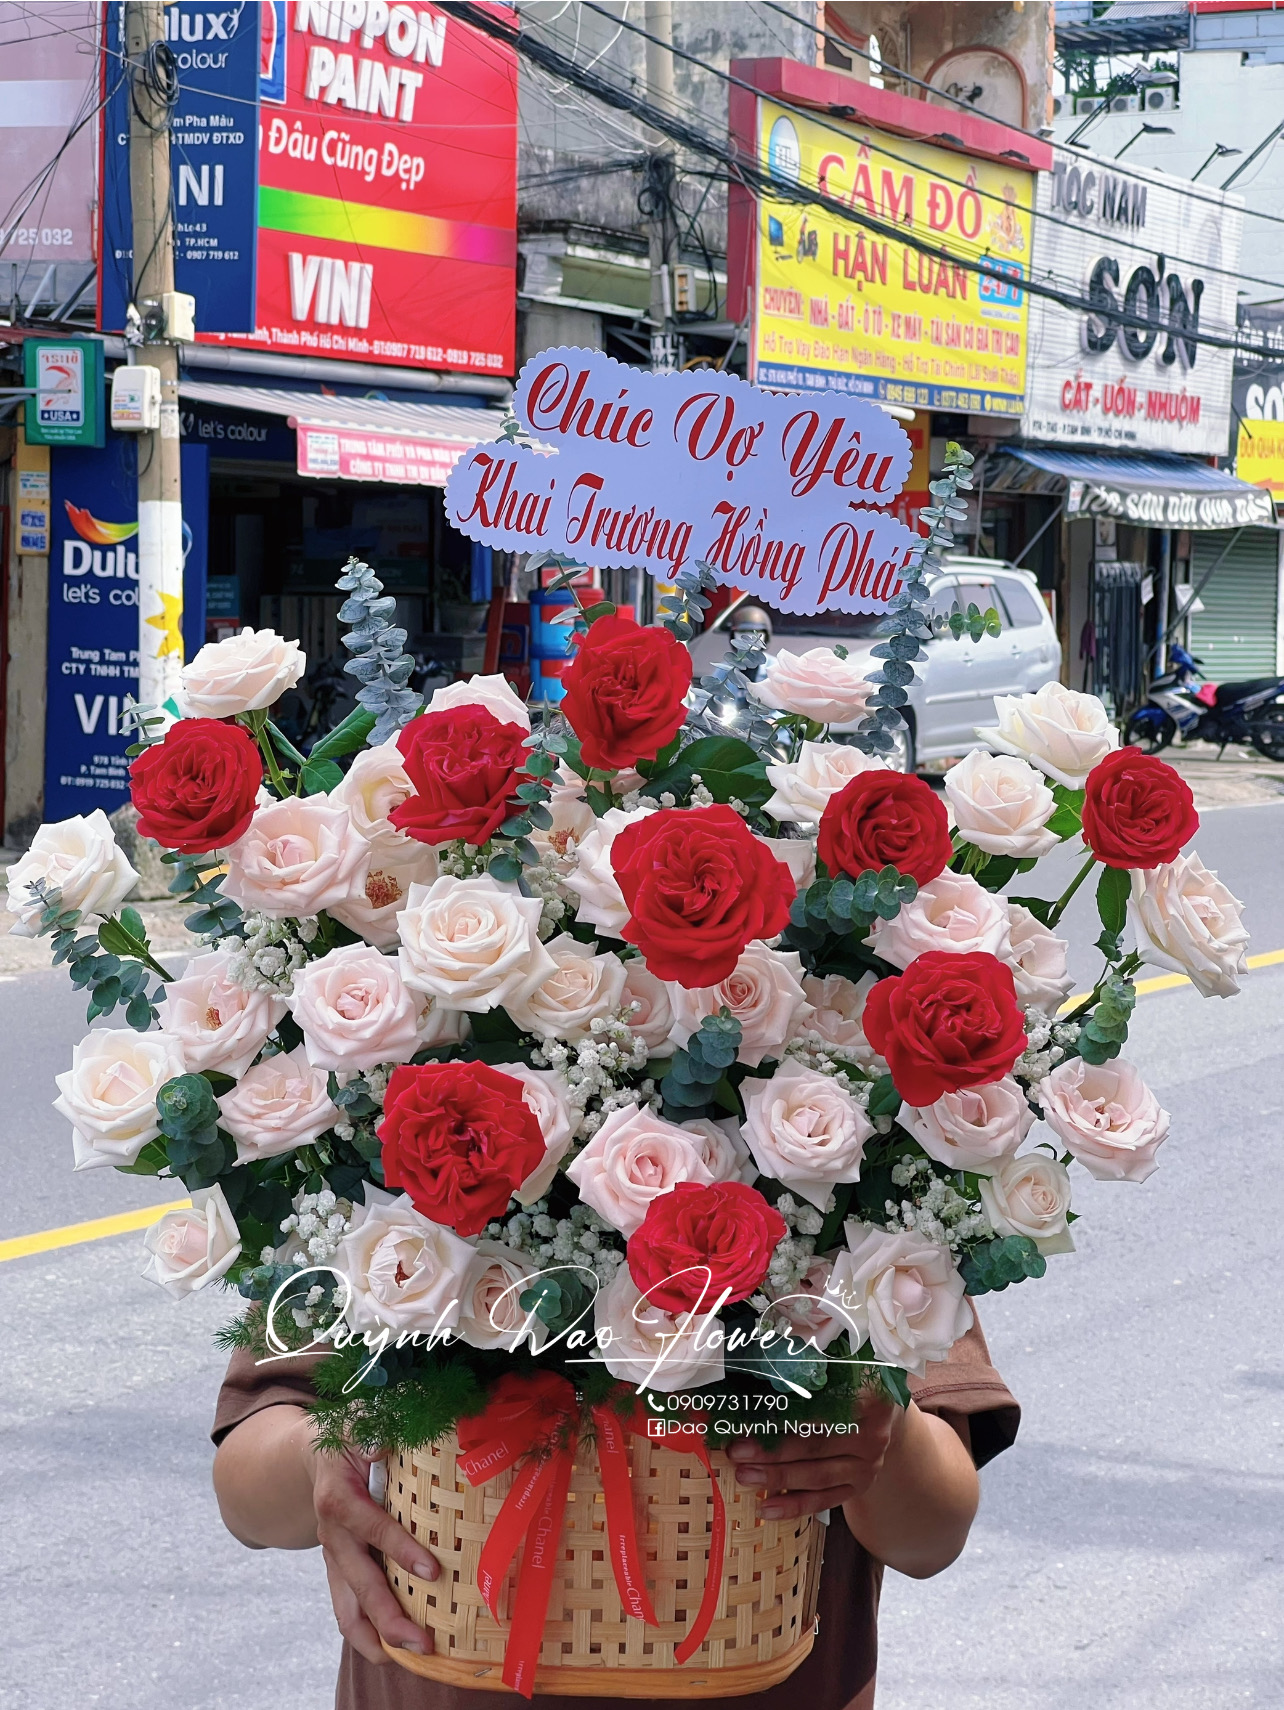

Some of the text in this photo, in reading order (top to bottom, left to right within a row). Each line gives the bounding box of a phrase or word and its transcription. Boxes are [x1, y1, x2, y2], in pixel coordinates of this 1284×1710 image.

[173, 49, 229, 69] olour
[294, 2, 448, 68] NIPPON
[305, 45, 424, 123] PAINT
[268, 117, 425, 191] Đâu Cũng Đẹp
[926, 164, 983, 239] ĐỒ
[41, 228, 74, 246] 032
[288, 252, 373, 330] VINI
[1083, 252, 1205, 370] SƠN
[50, 411, 73, 421] USA
[1061, 368, 1202, 430] CẮT UỐN NHUỘM
[227, 422, 268, 442] colour
[525, 362, 894, 498] Chúc Vợ Yêu
[456, 452, 557, 538] Khai
[565, 471, 697, 580] Trương
[704, 500, 808, 601] Hồng
[63, 539, 140, 581] Dulu
[63, 582, 101, 604] let's
[61, 661, 87, 675] CTY
[464, 1440, 511, 1477] Chanel
[531, 1516, 553, 1569] Chanel
